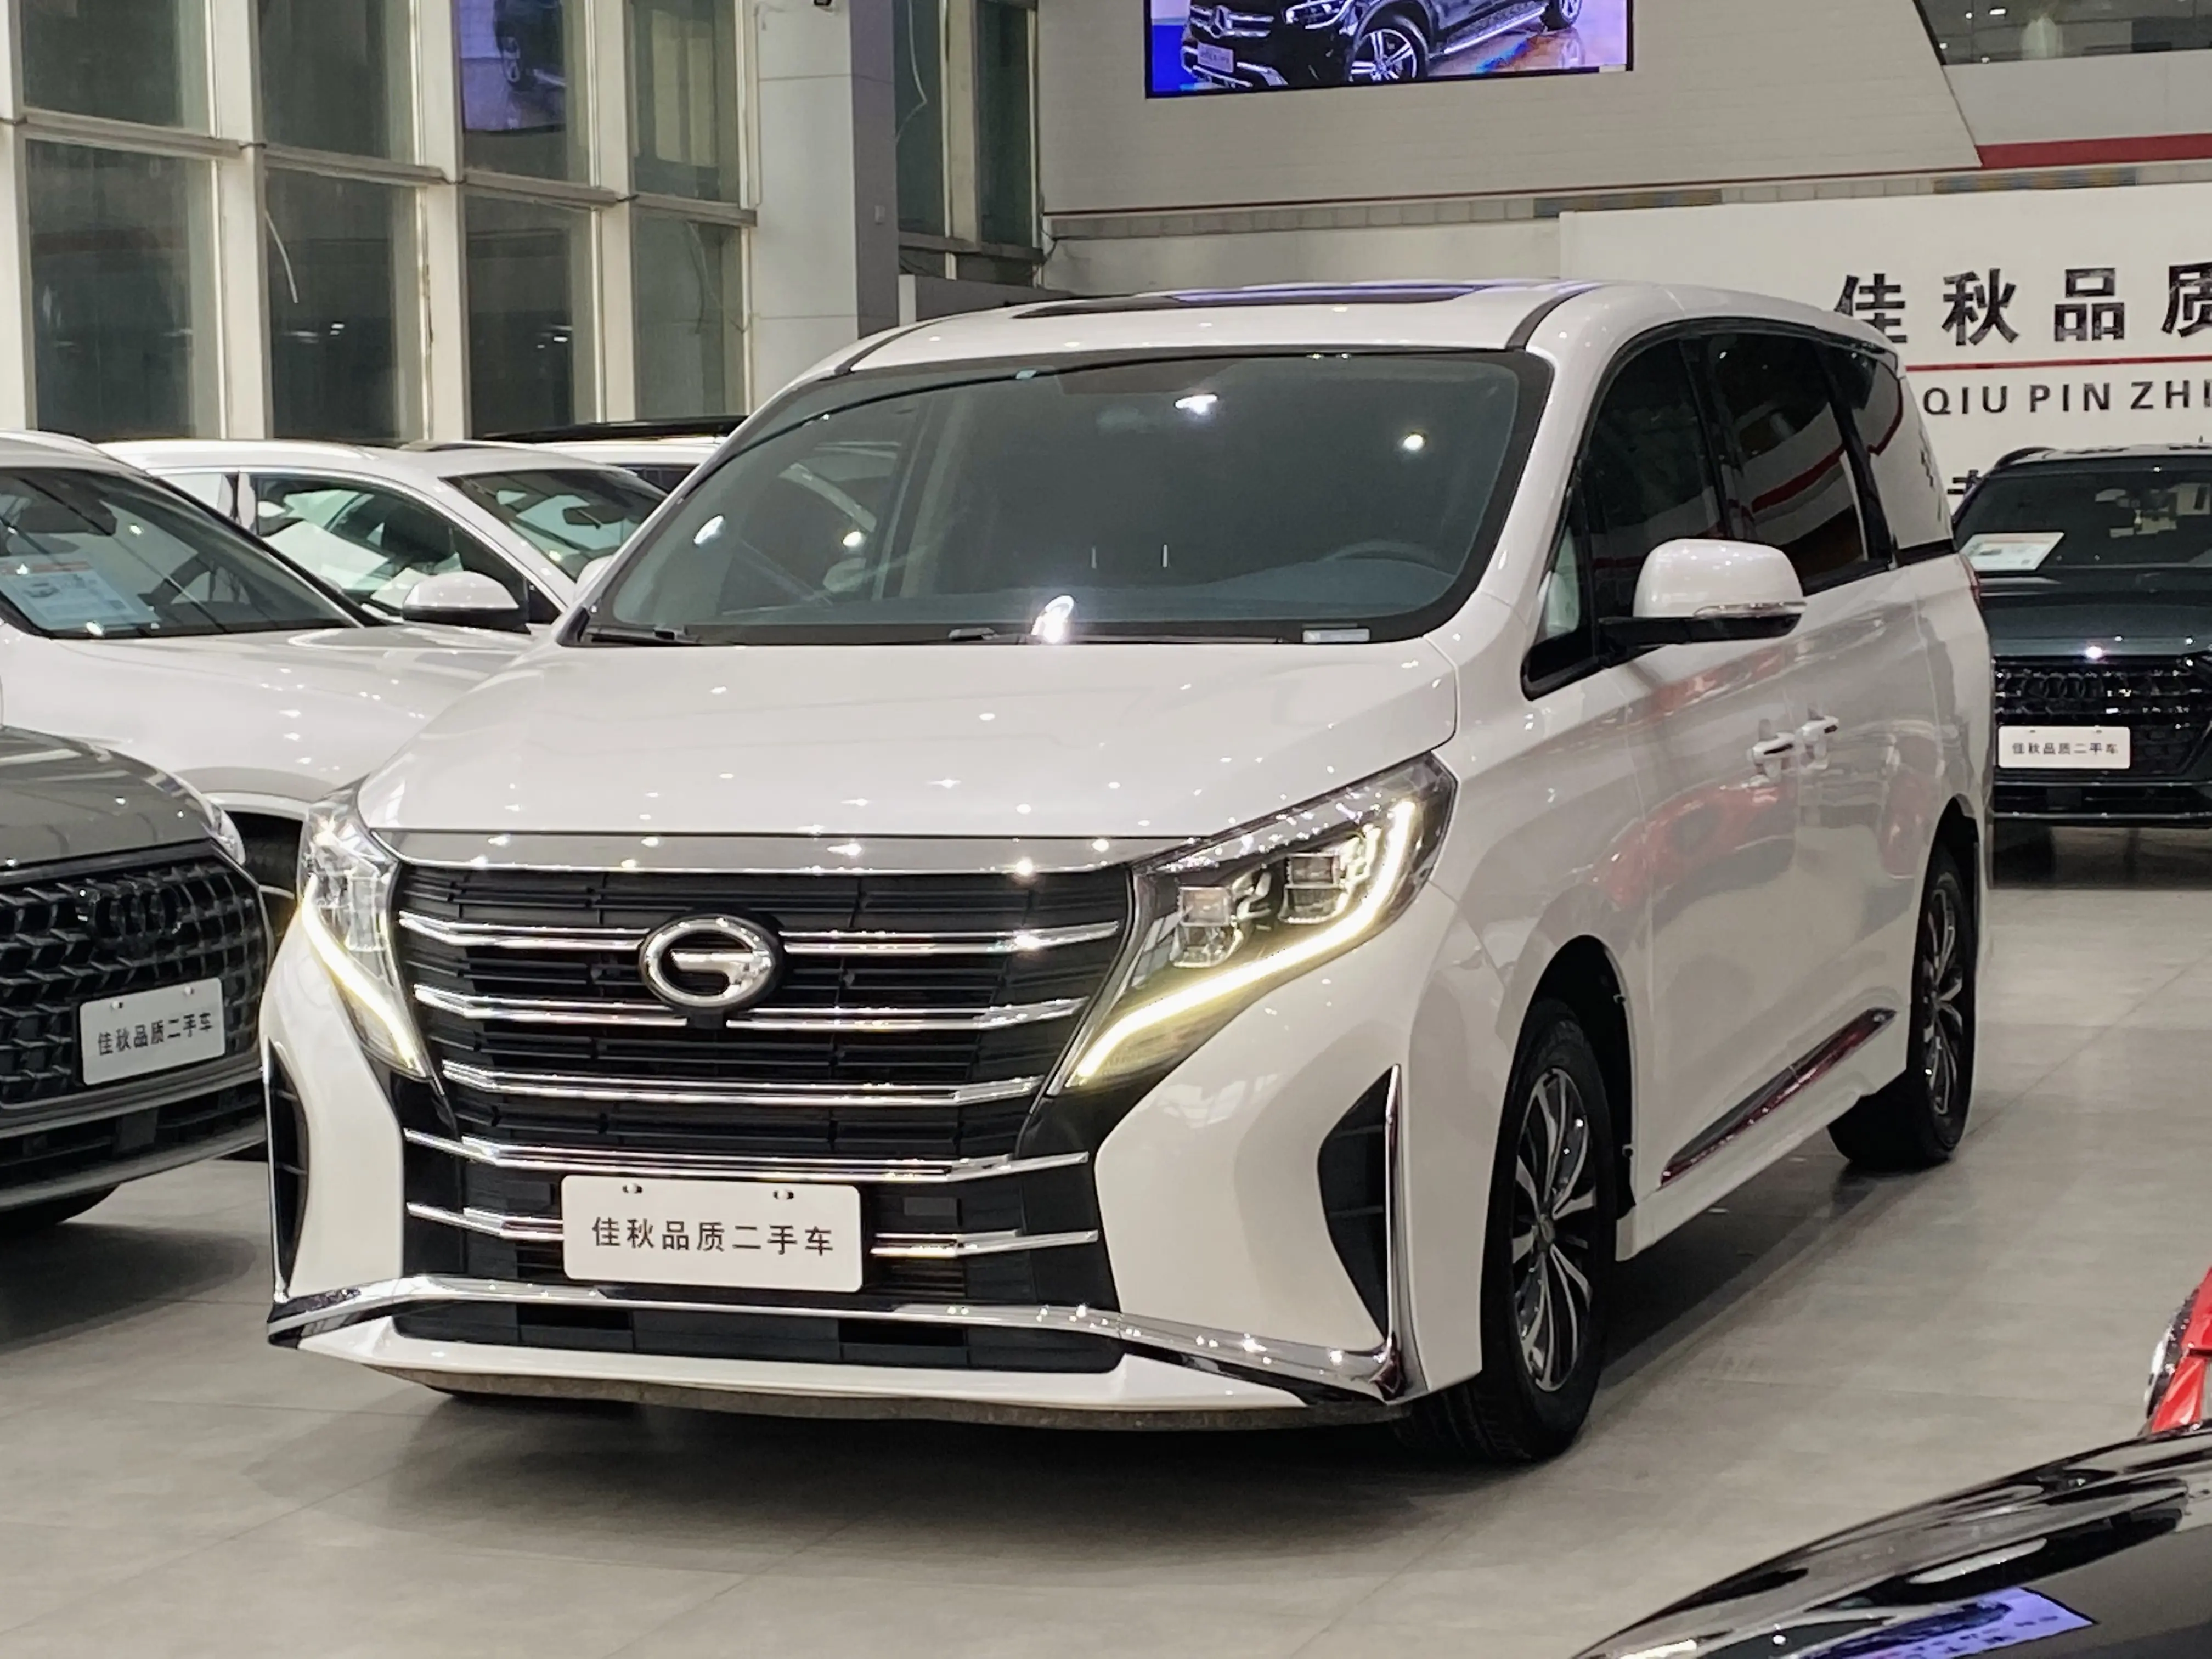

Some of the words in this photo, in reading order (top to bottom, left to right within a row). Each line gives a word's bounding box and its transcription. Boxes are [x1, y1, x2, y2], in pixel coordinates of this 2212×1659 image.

[1923, 385, 2008, 415] QIU
[2030, 382, 2110, 413] PIN
[98, 1012, 213, 1056] 佳秋品质二手车
[592, 1216, 833, 1256] 佳秋品质二手车
